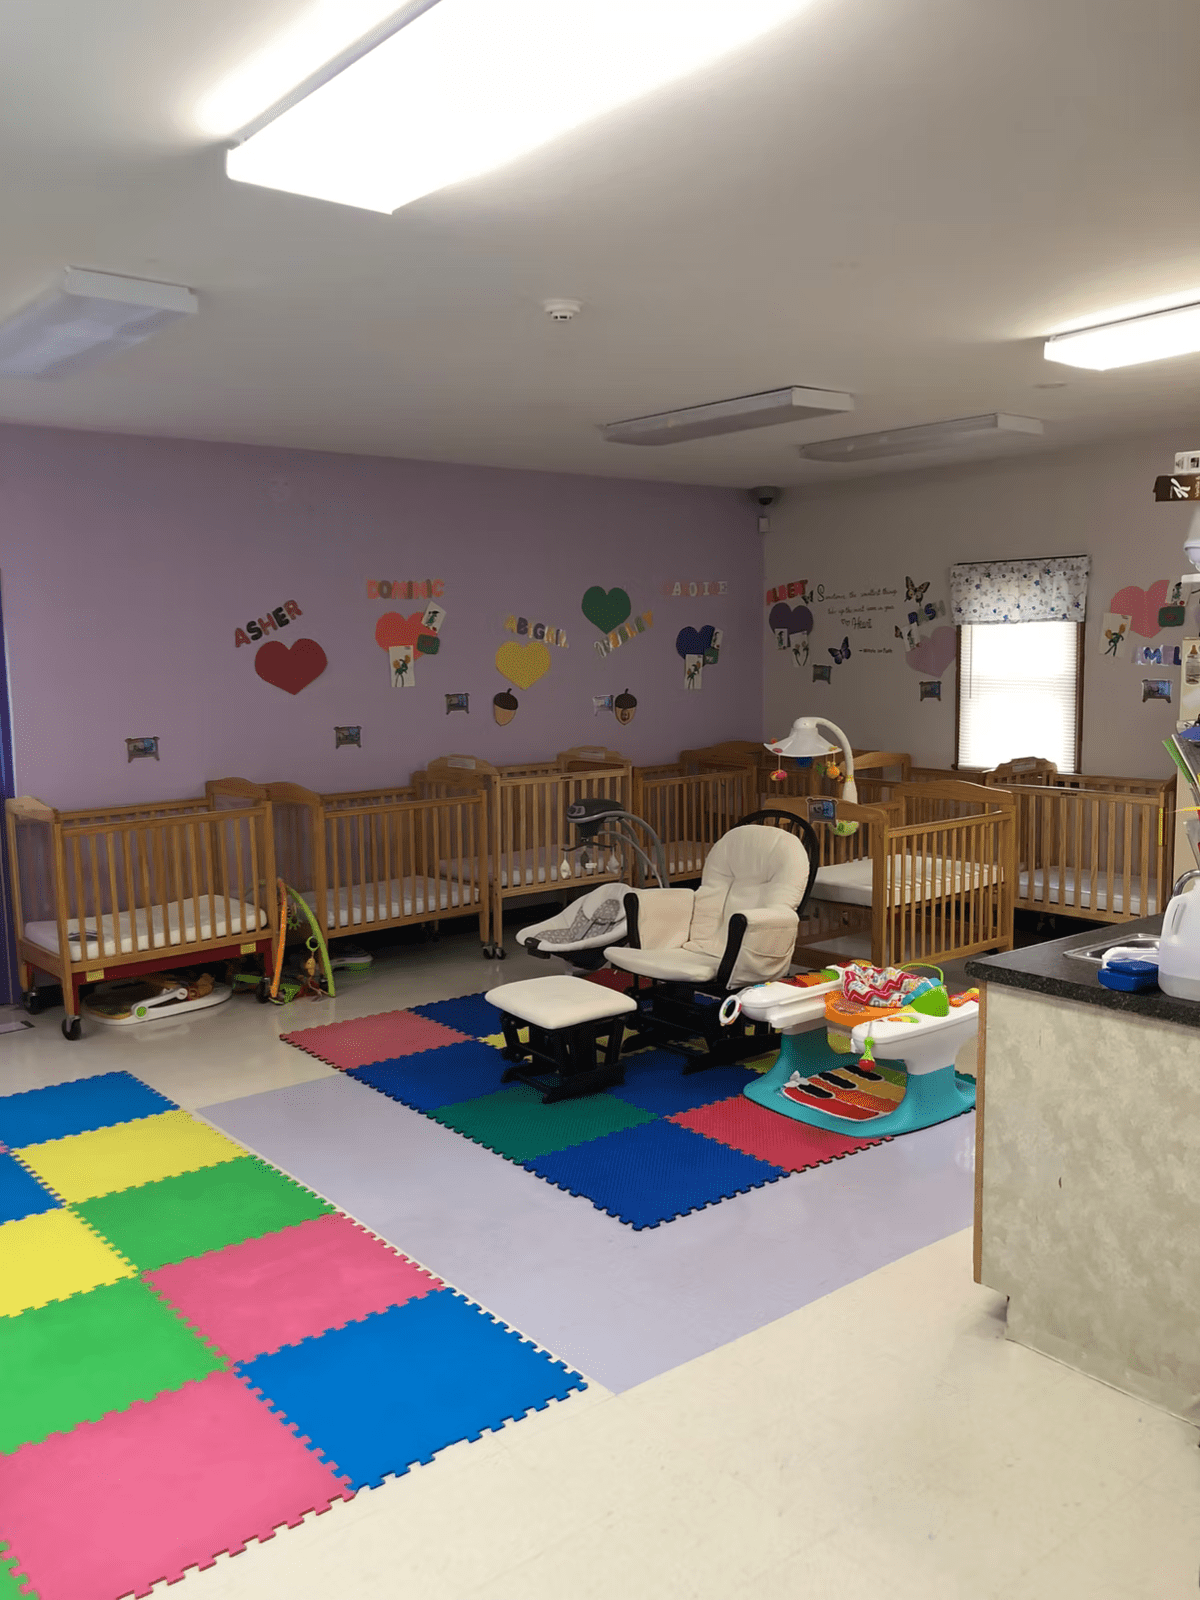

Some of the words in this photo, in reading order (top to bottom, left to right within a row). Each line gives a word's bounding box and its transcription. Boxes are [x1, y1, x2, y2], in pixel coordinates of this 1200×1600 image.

[367, 579, 445, 600] DOMINIC
[766, 579, 808, 605] ALBERT
[235, 600, 302, 648] ASHER
